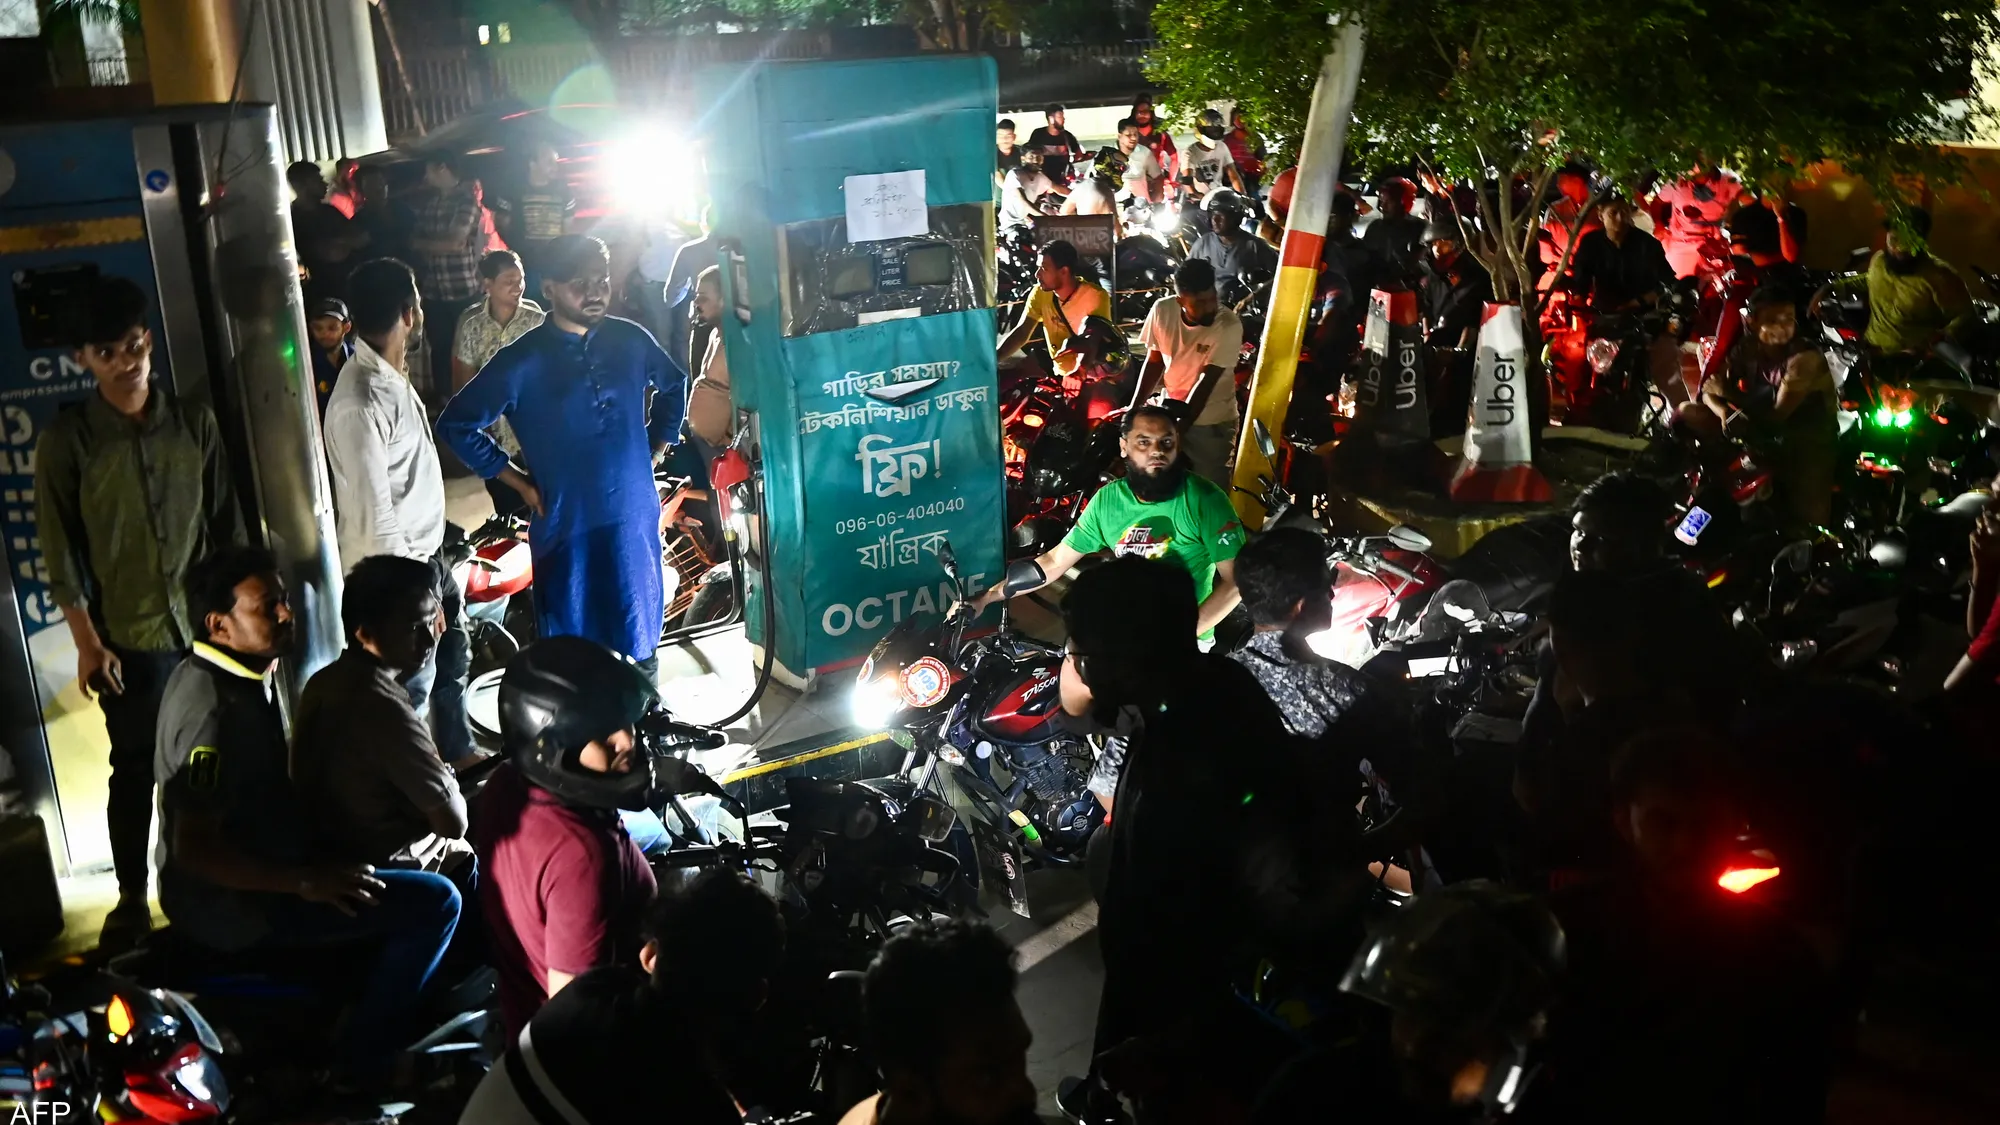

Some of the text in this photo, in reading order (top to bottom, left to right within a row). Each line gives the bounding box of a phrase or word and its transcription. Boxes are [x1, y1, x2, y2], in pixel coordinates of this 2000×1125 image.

[881, 257, 899, 265] SALE
[881, 267, 901, 276] LITER
[881, 278, 902, 287] PRICE
[29, 354, 86, 381] CN
[822, 361, 961, 397] গাড়ির সমস্যা?
[1361, 336, 1386, 407] Uber
[1395, 339, 1417, 411] Uber
[0, 381, 78, 401] ompressed
[935, 385, 989, 412] ডাকুন
[1486, 352, 1516, 426] Uber
[854, 433, 942, 498] ফ্রি!
[835, 497, 965, 535] 096-06-404040
[821, 572, 986, 637] OCTANE
[918, 668, 937, 691] 109
[1020, 675, 1059, 703] DISCO
